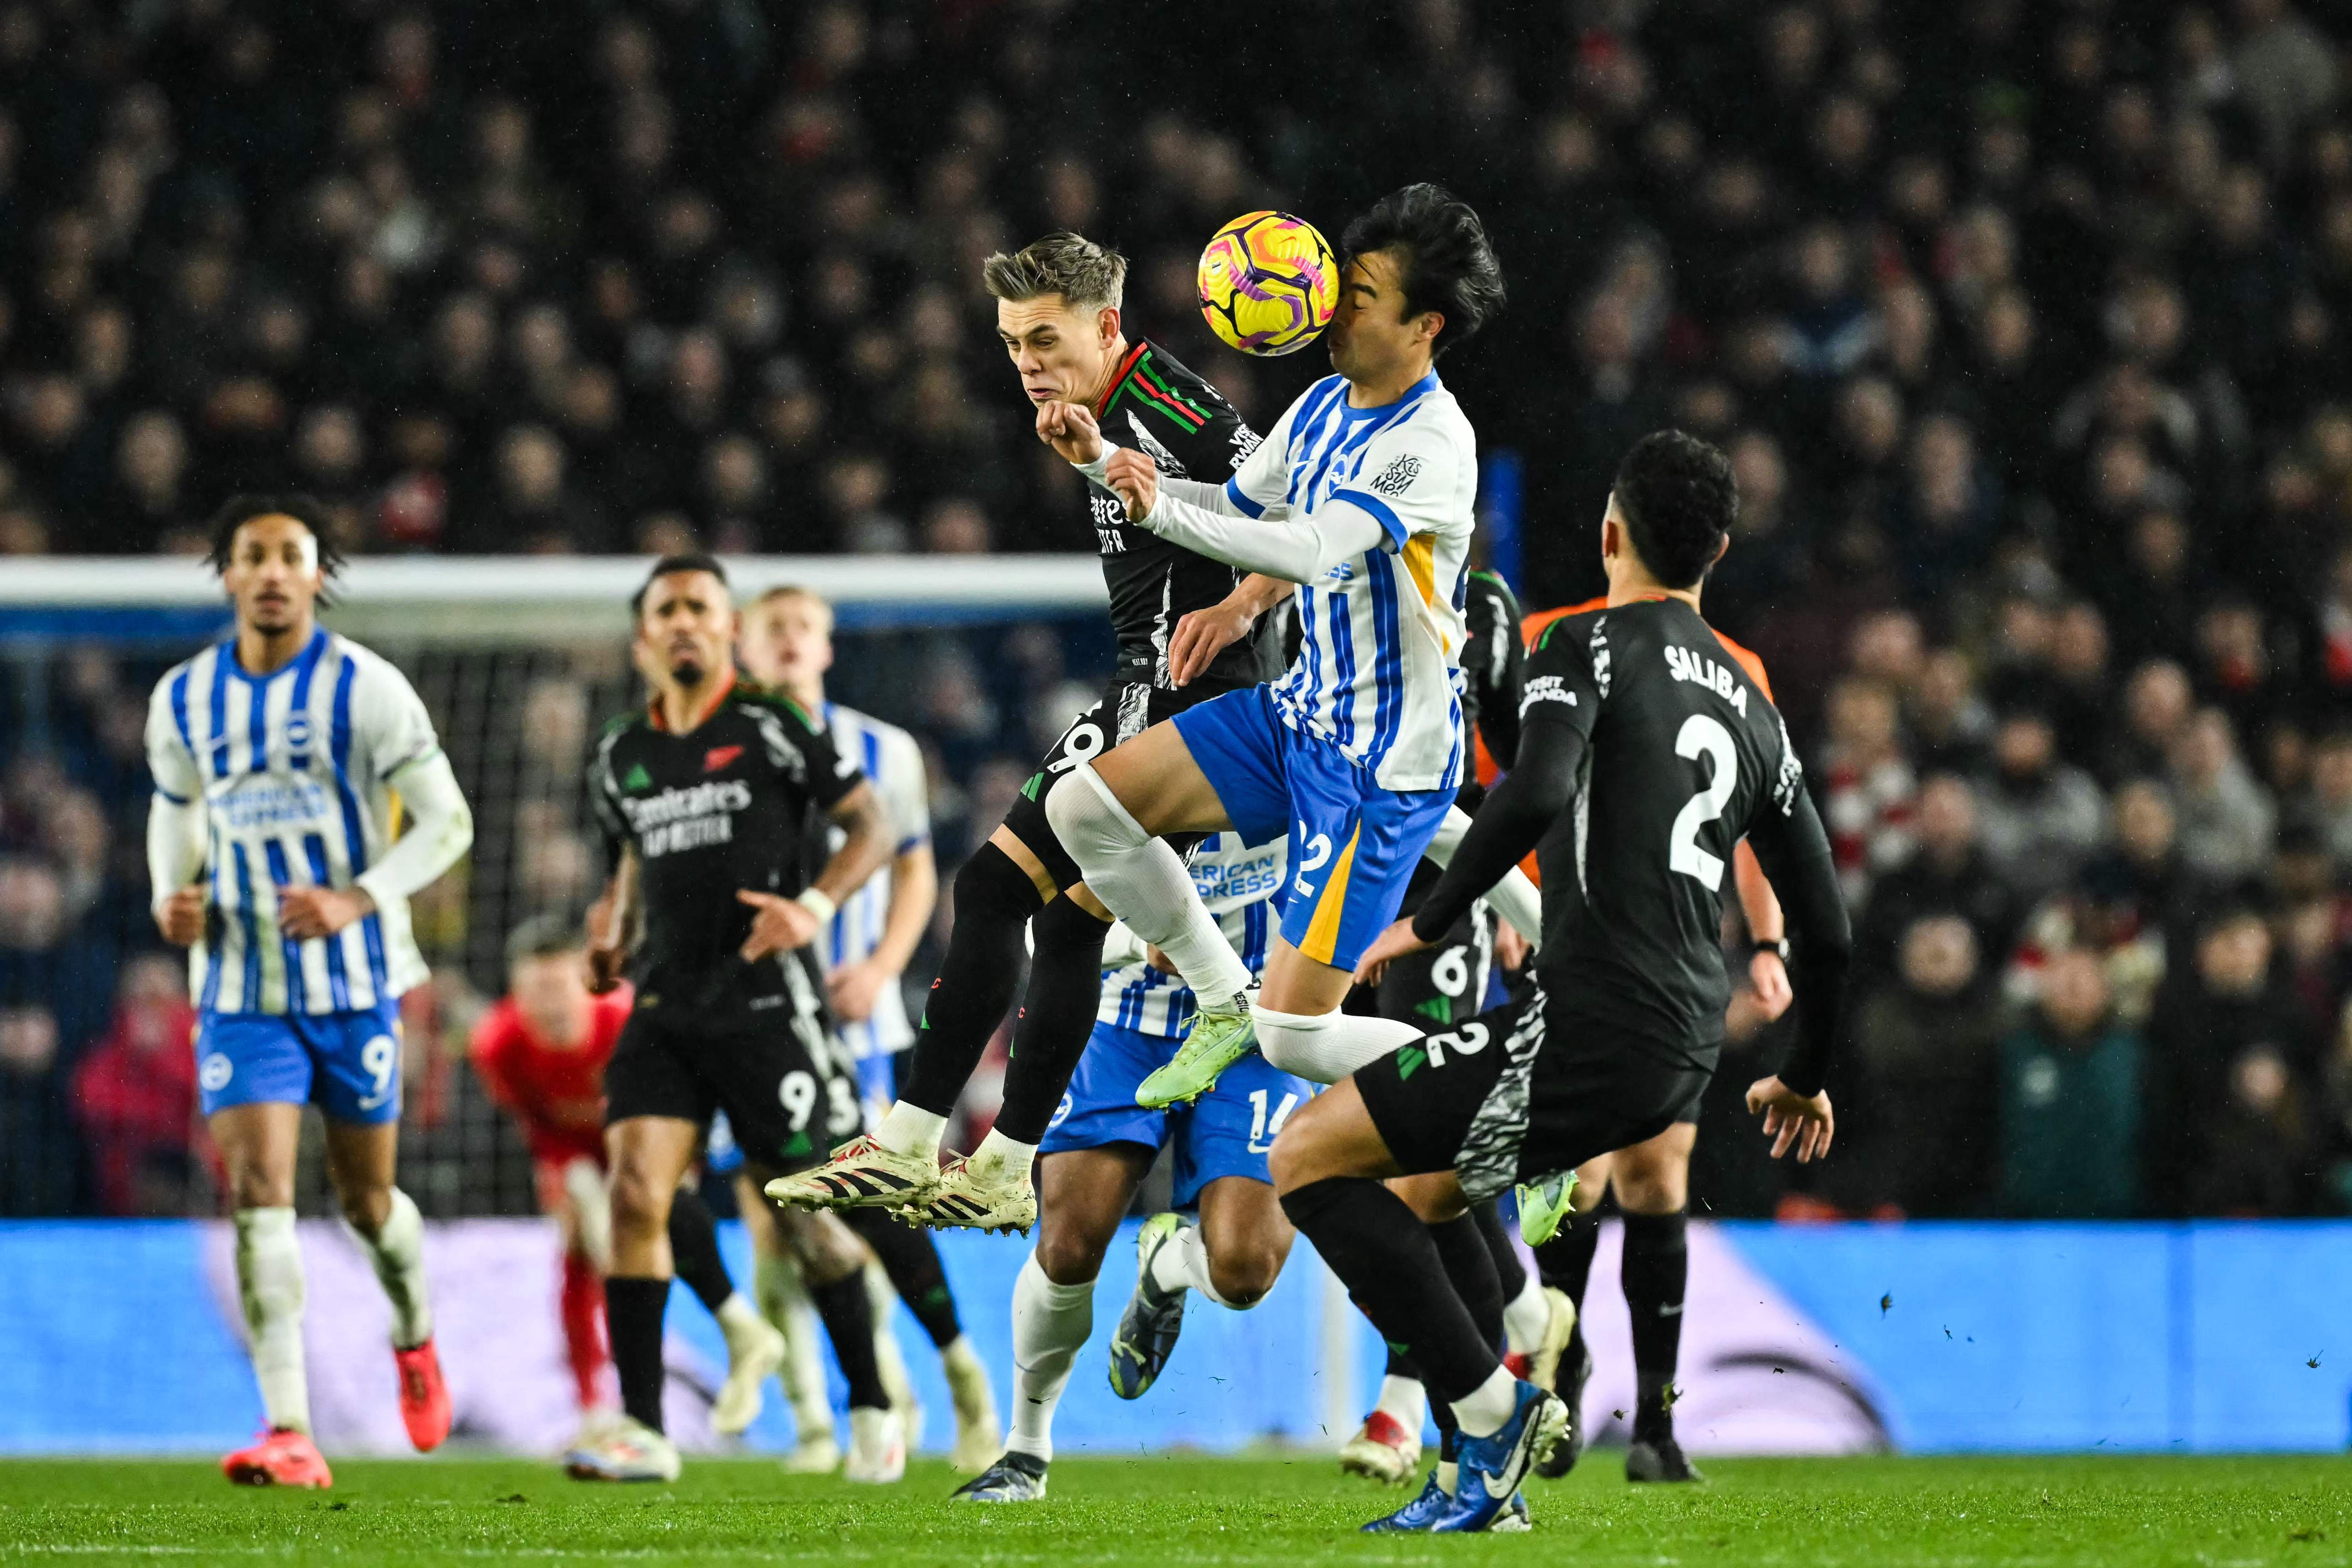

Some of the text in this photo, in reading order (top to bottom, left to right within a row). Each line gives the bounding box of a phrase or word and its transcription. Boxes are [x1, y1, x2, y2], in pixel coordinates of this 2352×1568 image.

[1664, 645, 1748, 720] SALIBA
[1670, 714, 1737, 893] 2
[1431, 945, 1469, 997] 6
[361, 1034, 396, 1094] 9
[1426, 1022, 1490, 1069] 2
[779, 1070, 817, 1132] 9
